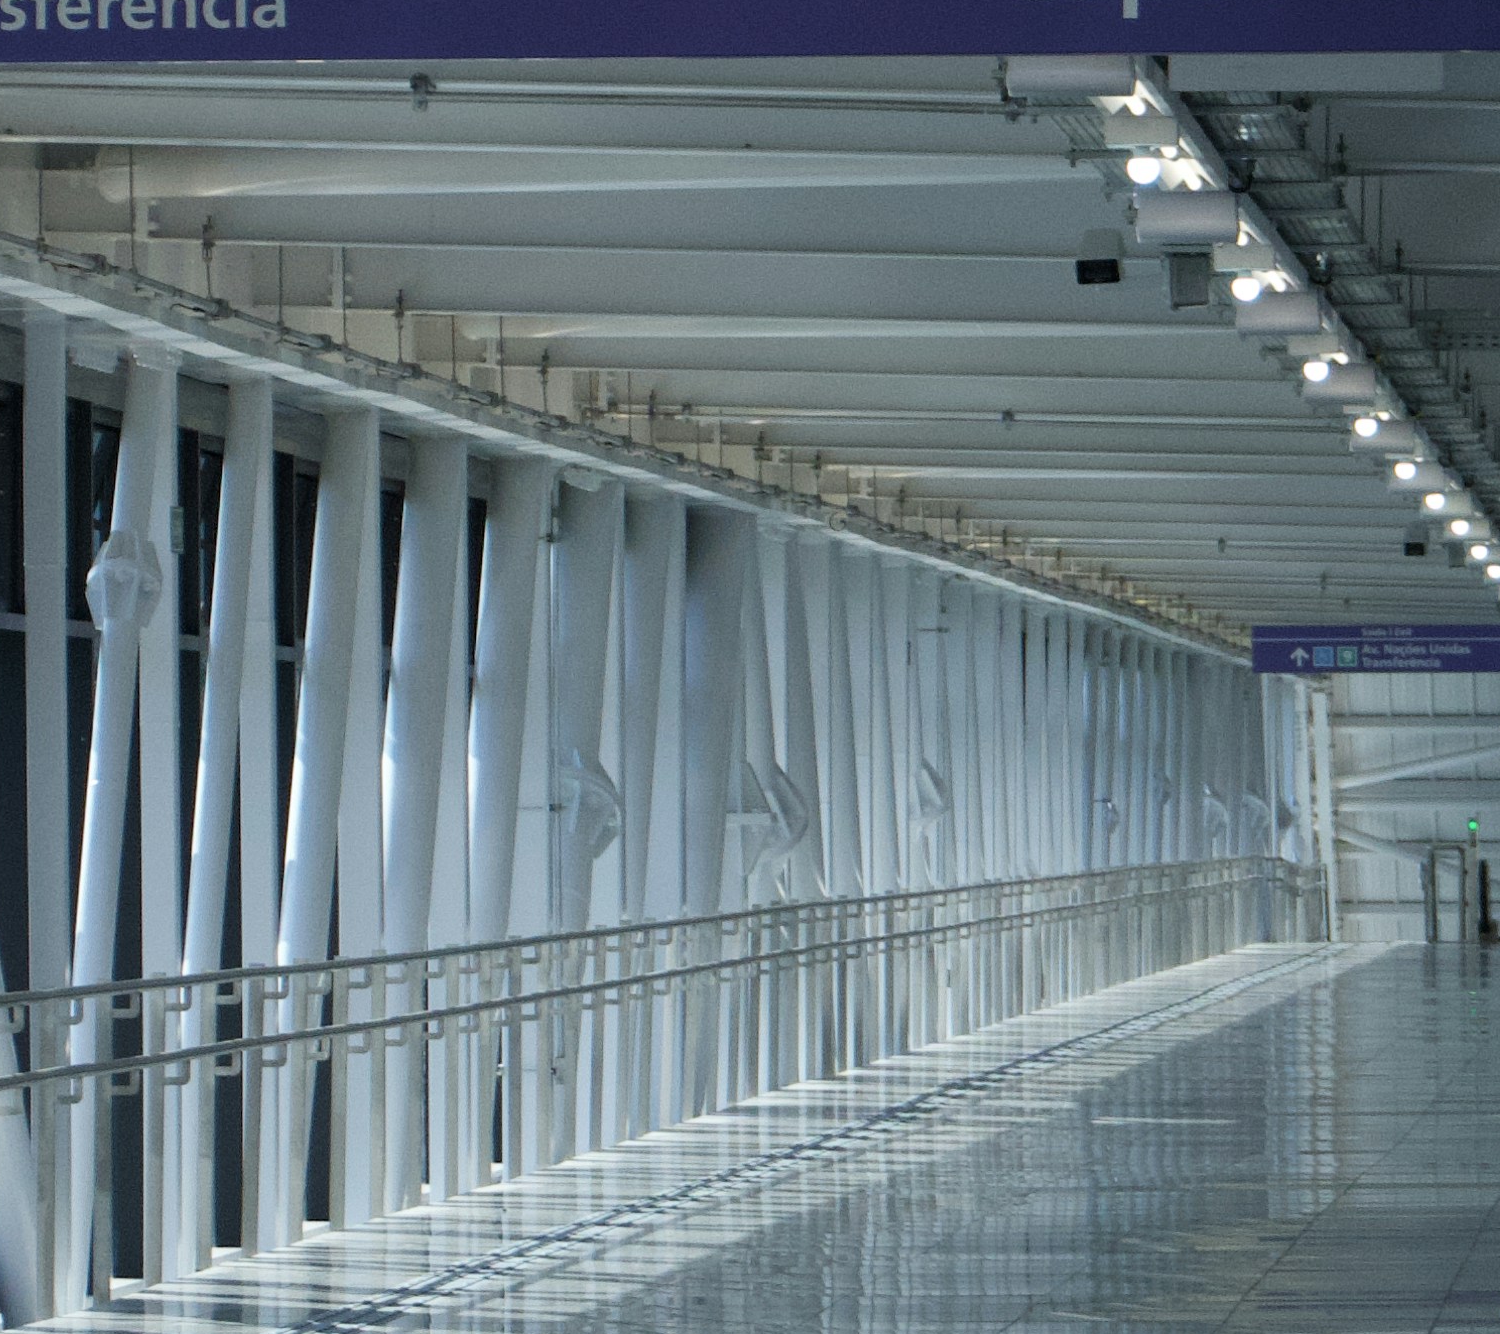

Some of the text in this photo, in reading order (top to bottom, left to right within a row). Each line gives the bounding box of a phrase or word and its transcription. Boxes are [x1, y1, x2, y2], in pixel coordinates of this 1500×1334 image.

[1383, 643, 1426, 657] Nações
[1428, 642, 1471, 654] Unidas
[1361, 656, 1441, 668] Transferência
